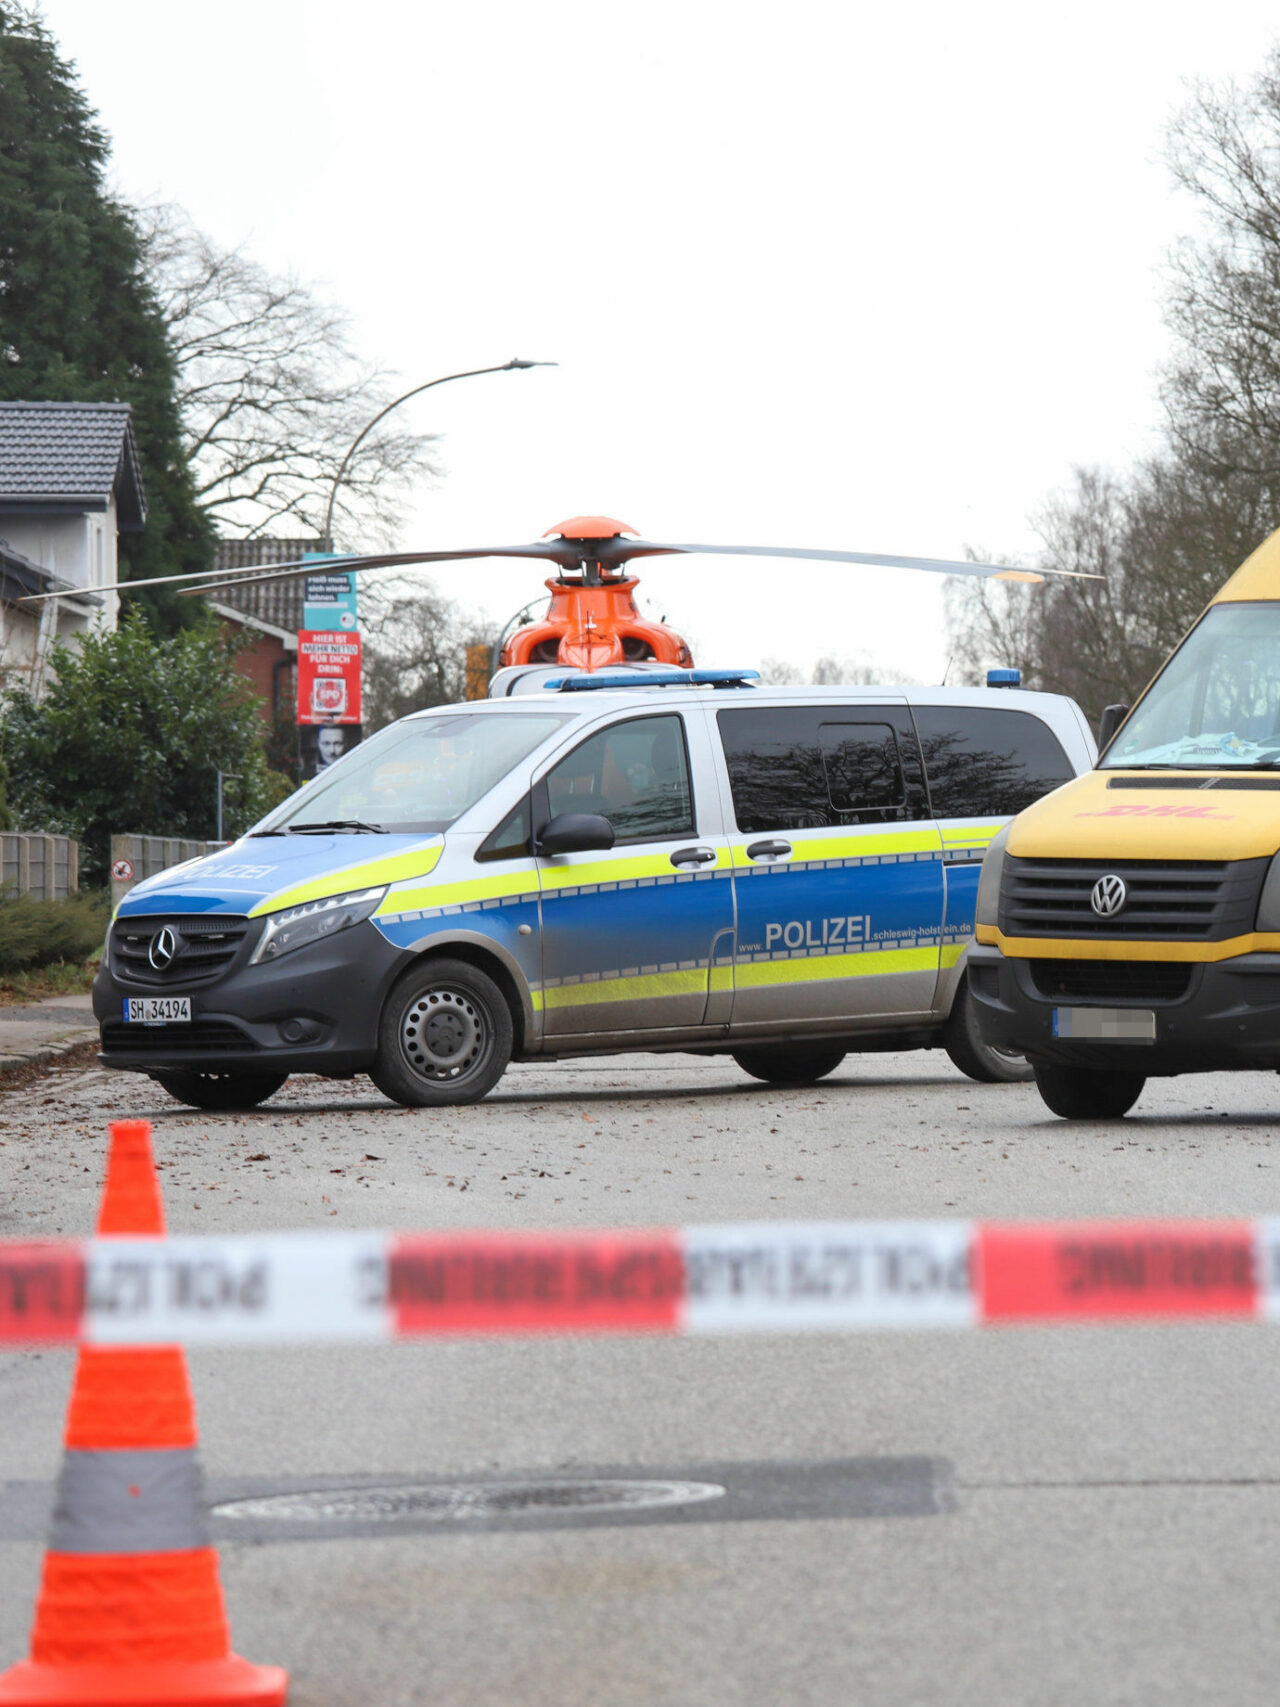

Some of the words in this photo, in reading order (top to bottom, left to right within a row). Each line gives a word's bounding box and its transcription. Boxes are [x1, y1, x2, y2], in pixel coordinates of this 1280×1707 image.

[312, 634, 334, 643] HIER
[335, 635, 348, 643] IST
[303, 644, 328, 653] MEHR
[331, 645, 357, 653] NETTO
[310, 653, 328, 663] FÜR
[329, 655, 351, 664] DICH
[1100, 804, 1218, 819] DHL
[130, 1000, 145, 1020] SH
[151, 1000, 189, 1019] 34194
